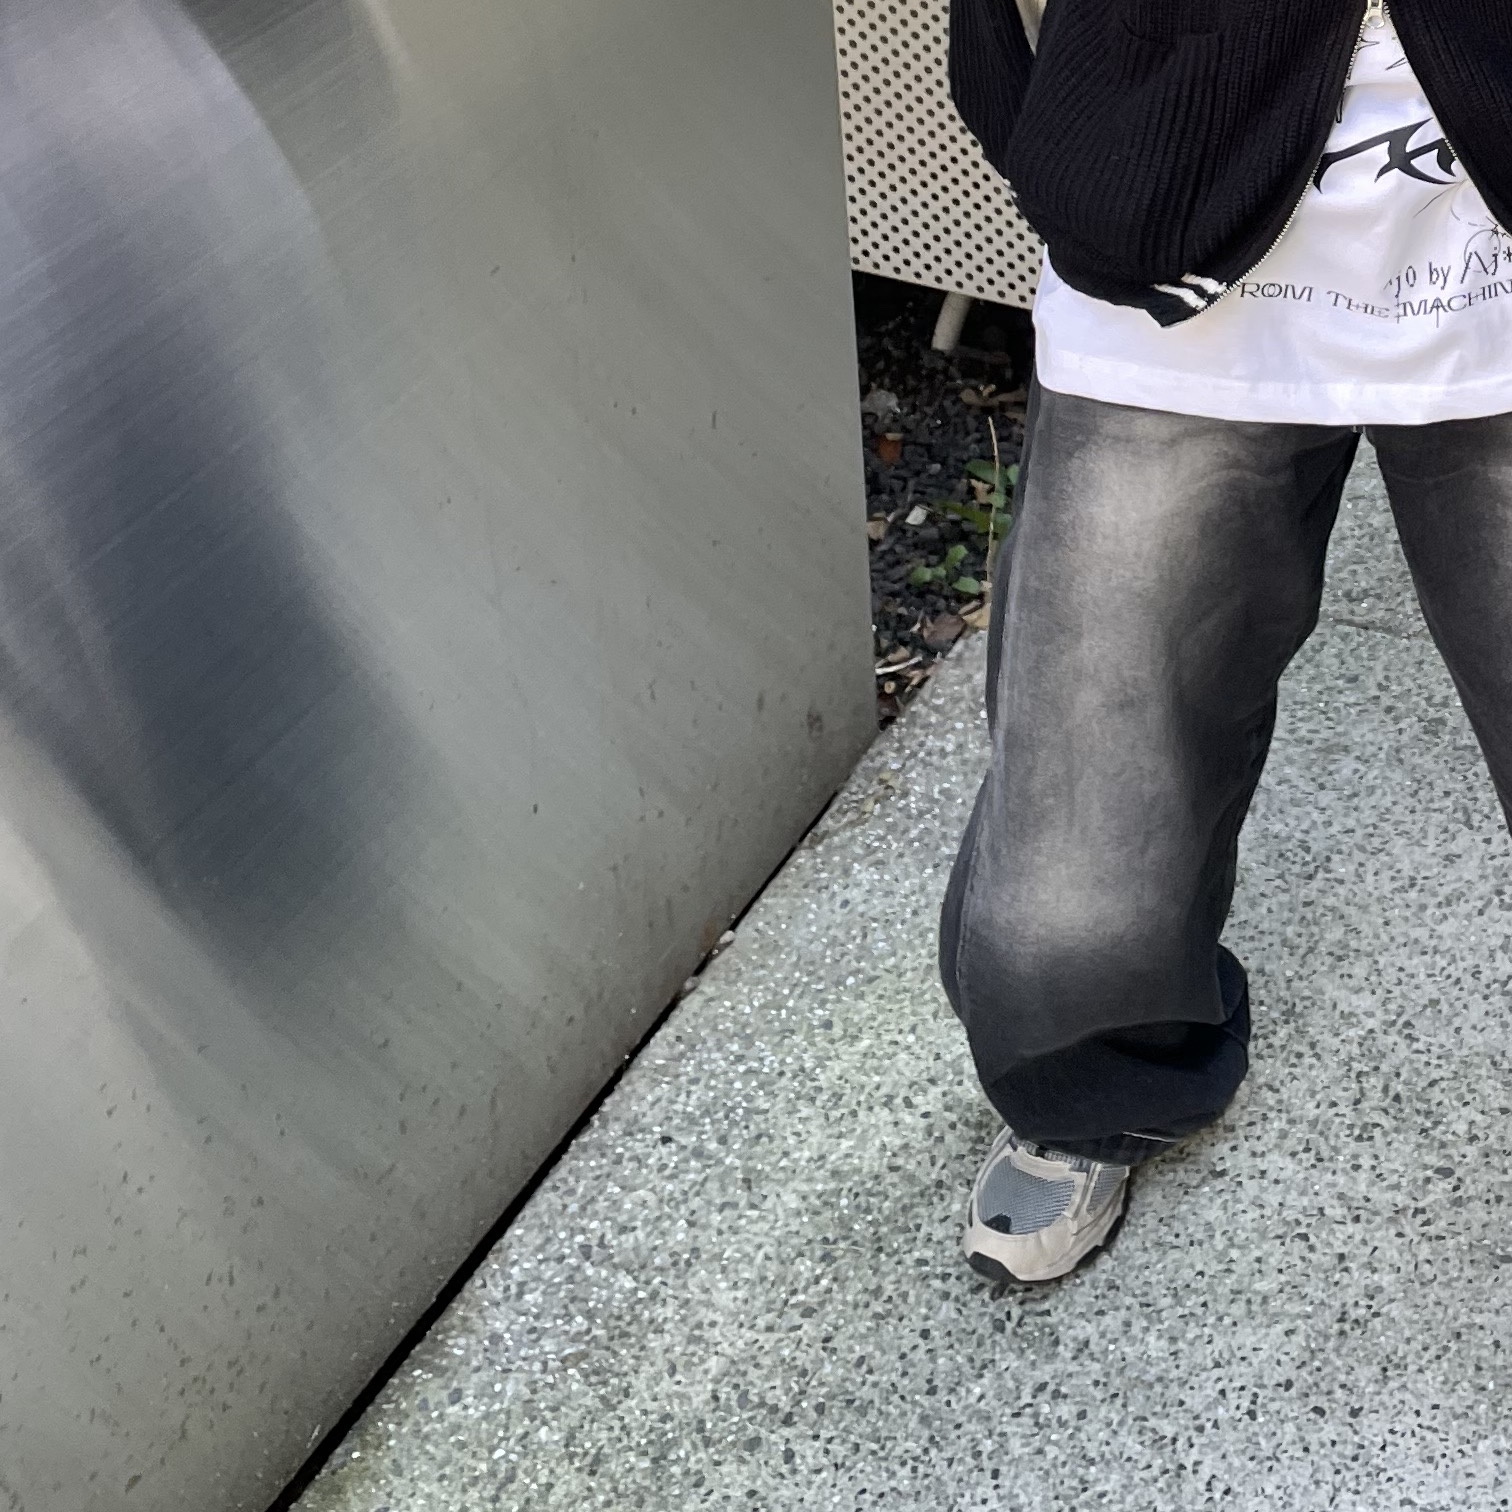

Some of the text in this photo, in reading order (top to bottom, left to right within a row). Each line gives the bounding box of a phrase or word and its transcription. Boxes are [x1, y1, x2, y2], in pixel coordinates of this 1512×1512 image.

[1428, 261, 1452, 291] by
[1238, 282, 1314, 303] ROM
[1326, 290, 1390, 319] THE
